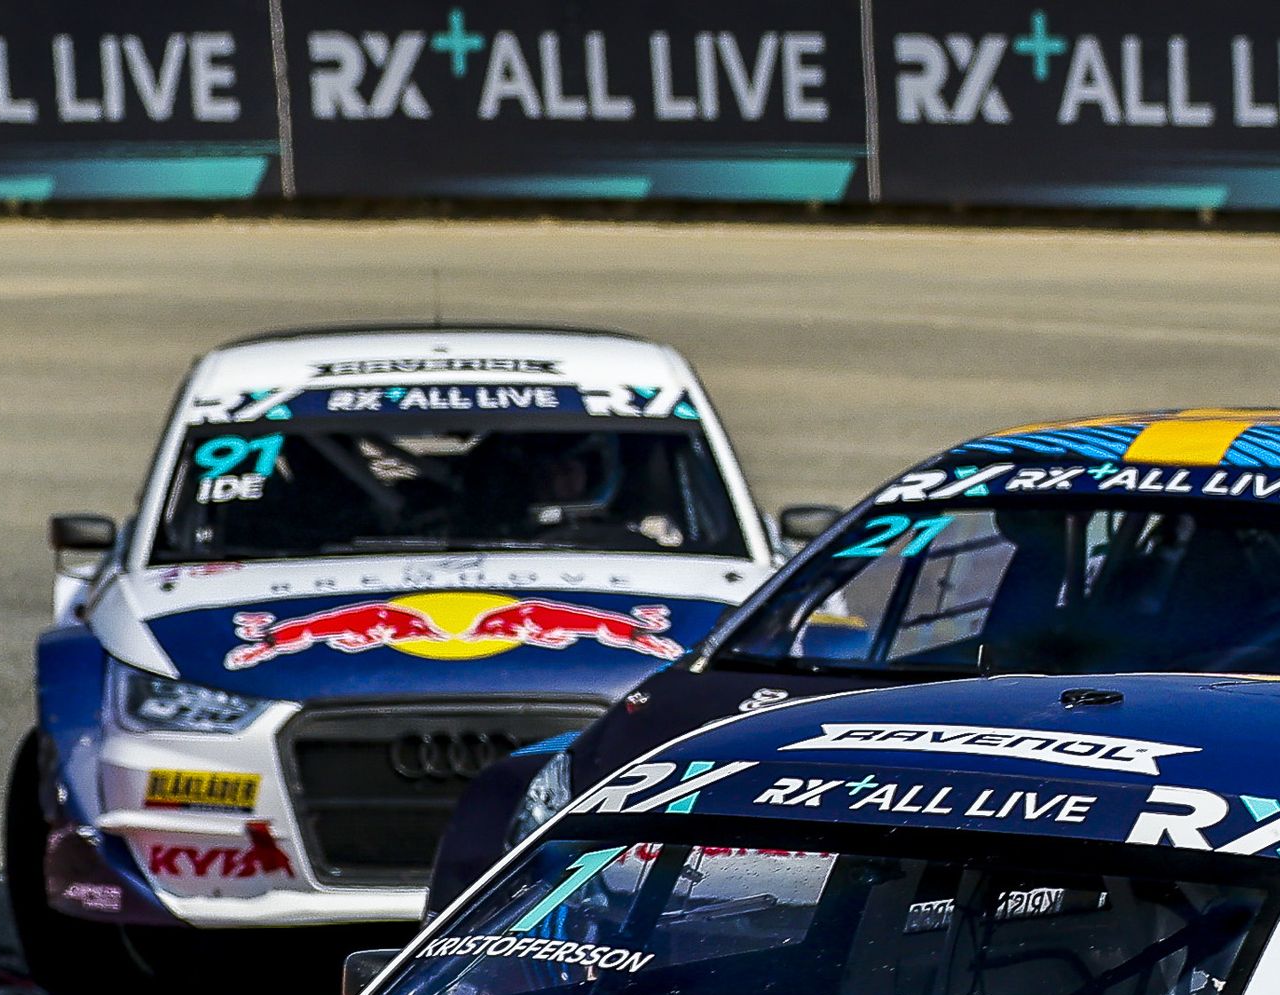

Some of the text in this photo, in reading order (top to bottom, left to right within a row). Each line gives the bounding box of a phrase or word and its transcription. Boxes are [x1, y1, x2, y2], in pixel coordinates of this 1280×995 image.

[53, 32, 241, 123] LIVE
[649, 30, 829, 121] LIVE
[476, 385, 560, 409] LIVE
[195, 432, 285, 478] 91
[197, 474, 266, 504] IDE
[875, 463, 1015, 505] RX
[832, 514, 956, 558] 21
[832, 729, 1148, 763] RAVENOL
[569, 761, 759, 814] RX
[963, 789, 1097, 824] LIVE
[510, 845, 628, 932] 1
[416, 934, 656, 973] KRISTOFFERSSON
